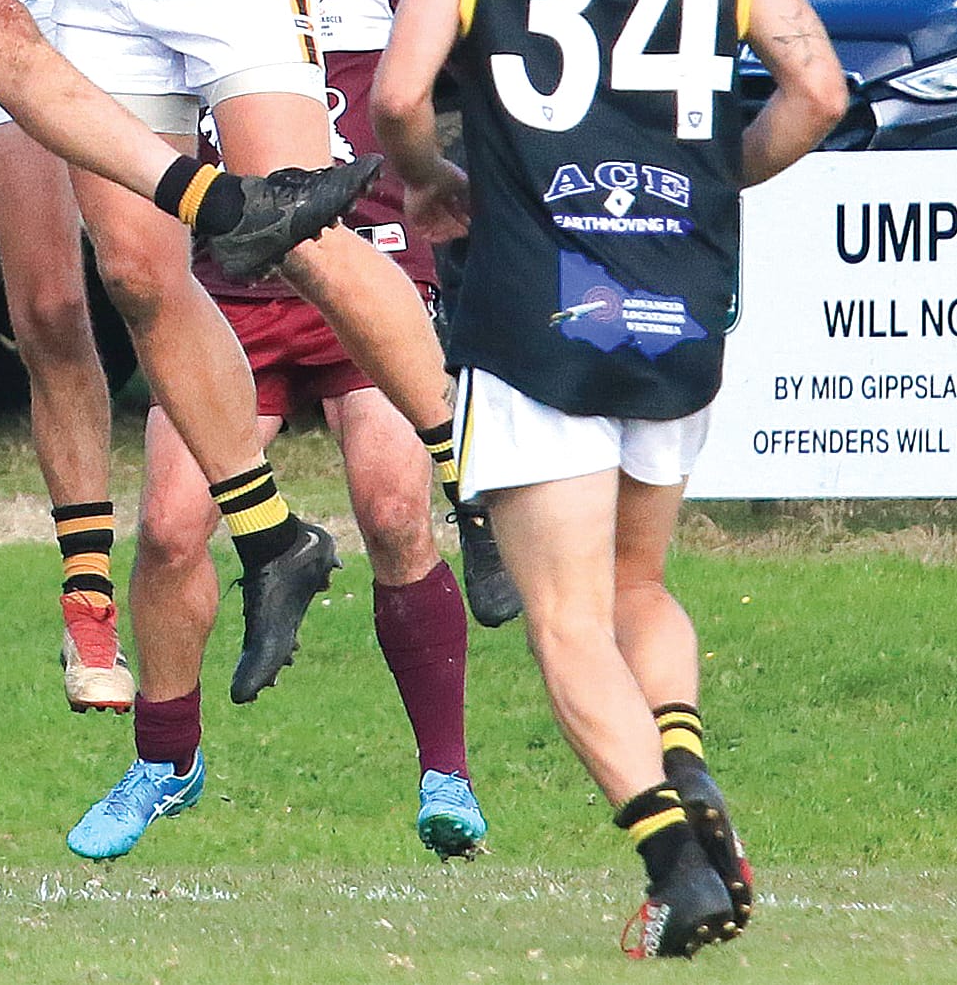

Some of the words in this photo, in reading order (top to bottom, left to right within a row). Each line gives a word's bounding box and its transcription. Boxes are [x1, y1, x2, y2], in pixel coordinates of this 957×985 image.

[544, 161, 691, 208] ACE
[552, 215, 665, 233] EARTHMOVING
[836, 201, 957, 265] UMP
[823, 299, 909, 338] WILL
[774, 375, 804, 400] BY
[811, 375, 854, 400] MID
[861, 374, 957, 399] GIPPSLA
[753, 429, 889, 455] OFFENDERS
[897, 428, 950, 454] WILL
